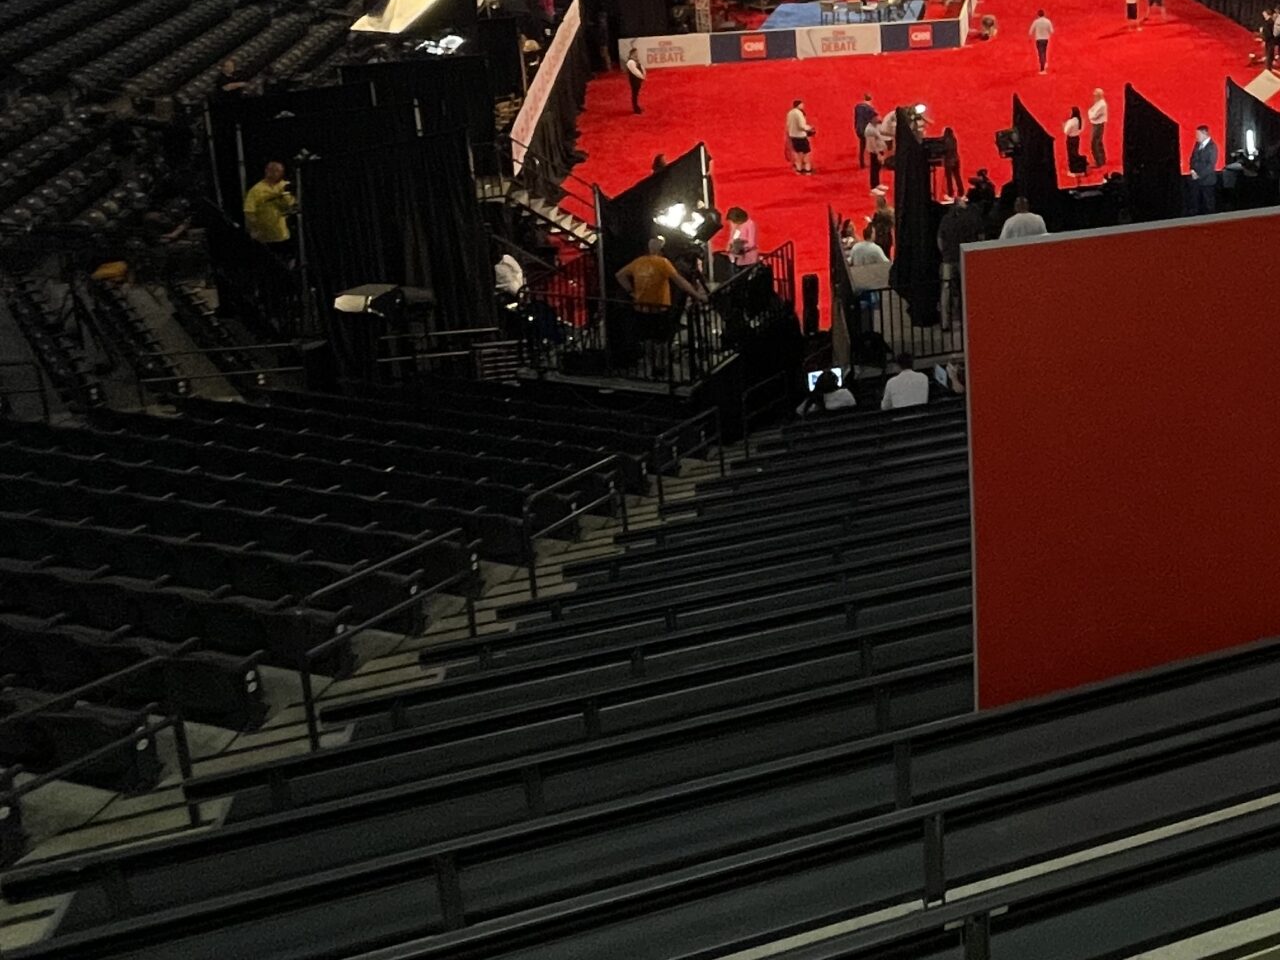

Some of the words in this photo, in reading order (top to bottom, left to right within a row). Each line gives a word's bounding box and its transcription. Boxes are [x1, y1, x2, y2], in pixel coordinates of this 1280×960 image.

[911, 32, 931, 41] CNN
[743, 41, 765, 52] CNN
[821, 41, 857, 53] DEBATE
[646, 52, 686, 65] DEBATE
